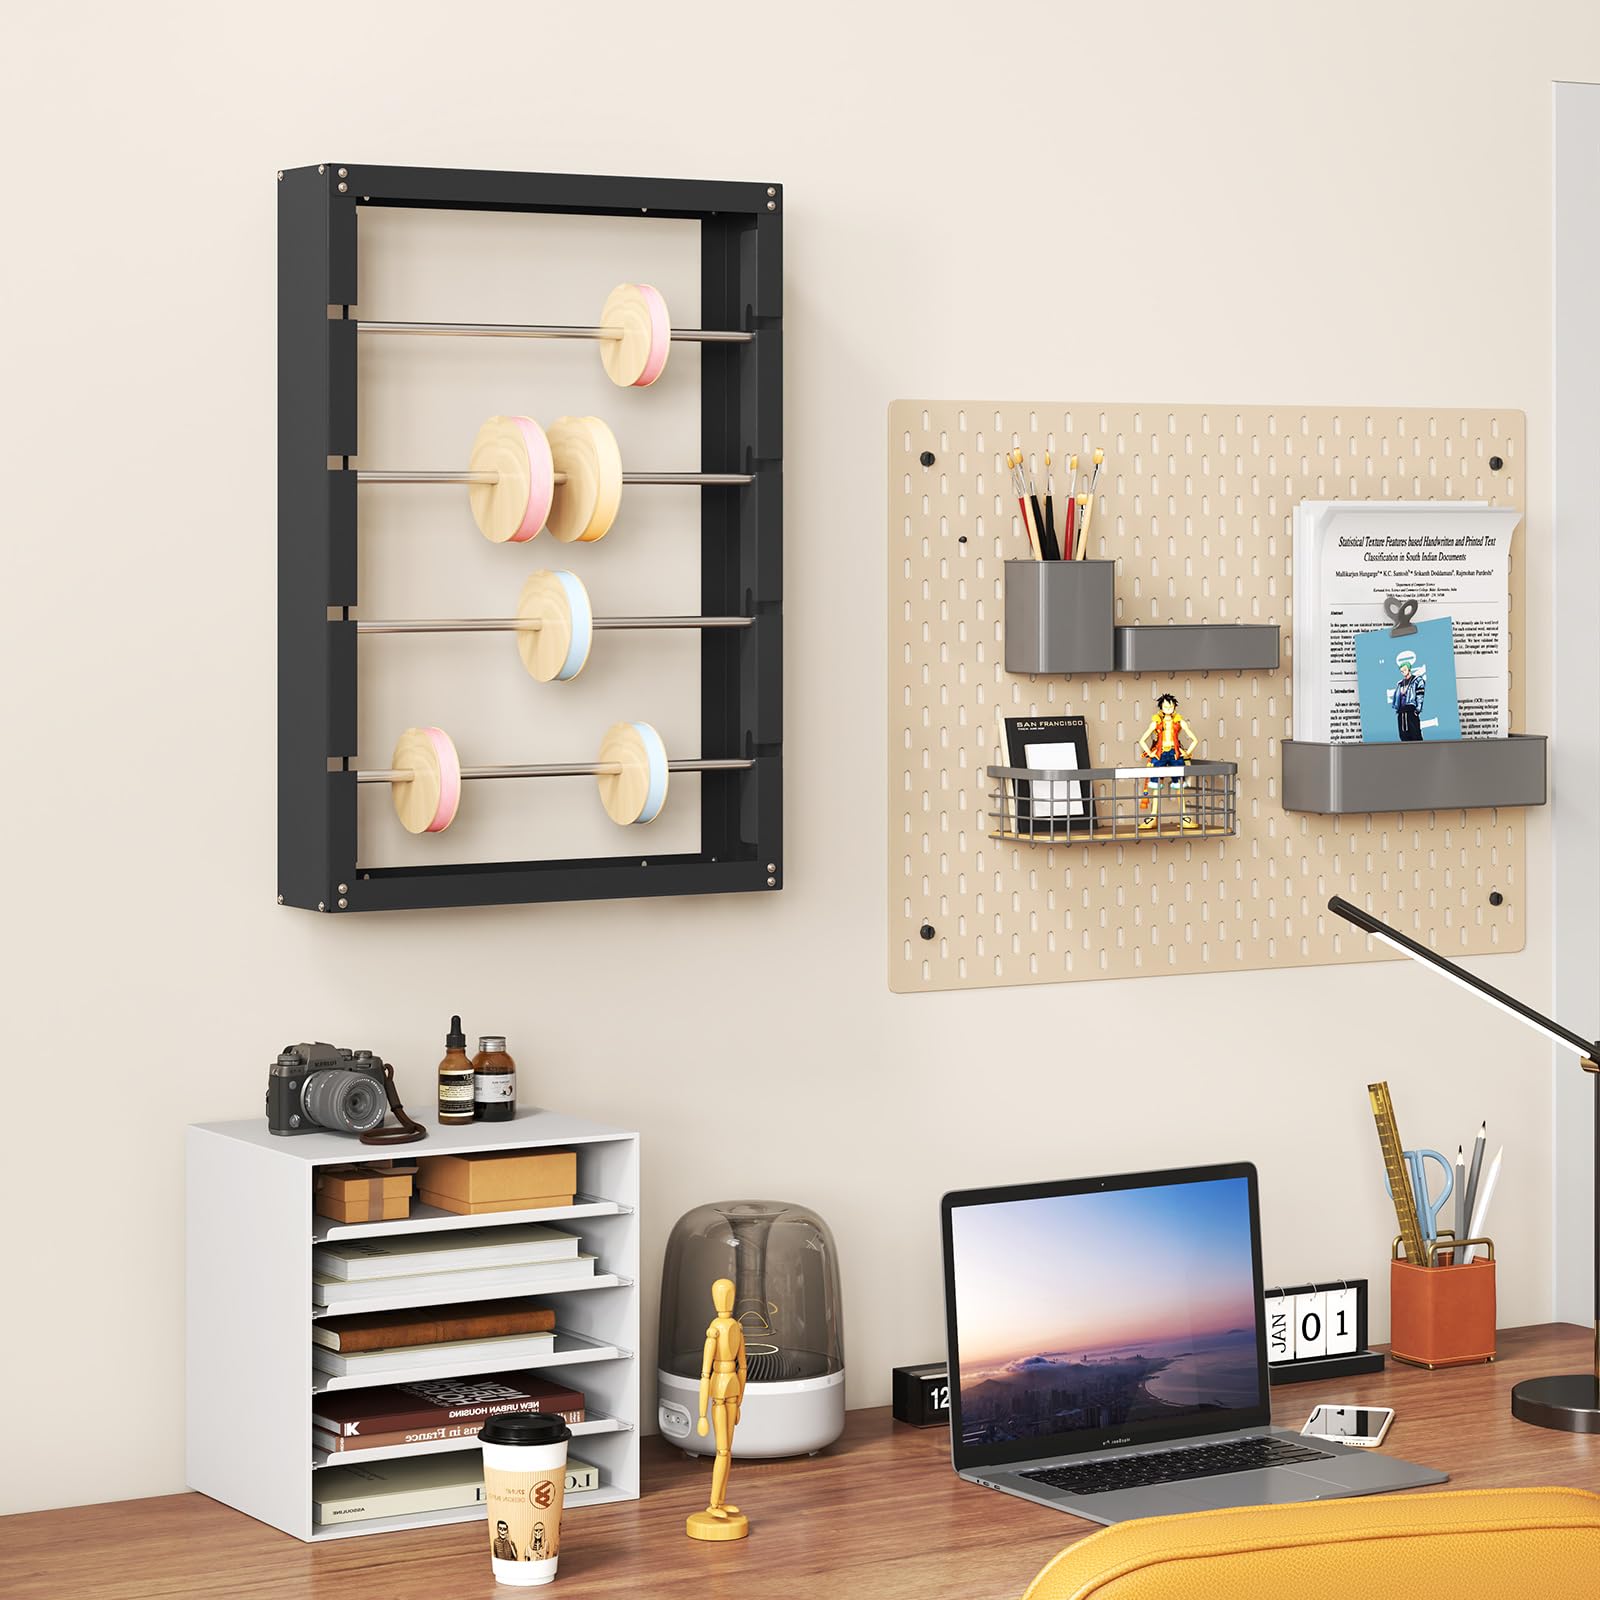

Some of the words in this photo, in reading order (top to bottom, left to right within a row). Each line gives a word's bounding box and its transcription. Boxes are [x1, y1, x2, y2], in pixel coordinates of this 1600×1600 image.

[1338, 536, 1364, 547] Statistical
[1366, 536, 1384, 547] Texture
[1386, 536, 1407, 547] Features
[1408, 536, 1423, 547] based
[1423, 536, 1454, 547] Handwritten
[1455, 536, 1464, 547] and
[1465, 536, 1484, 547] Printed
[1484, 536, 1496, 547] Text
[1364, 552, 1398, 562] Classification
[1400, 552, 1405, 562] in
[1406, 552, 1420, 562] South
[1422, 552, 1438, 562] Indian
[1439, 552, 1466, 562] Documents
[1272, 1314, 1286, 1353] JAN
[931, 1386, 949, 1409] 12
